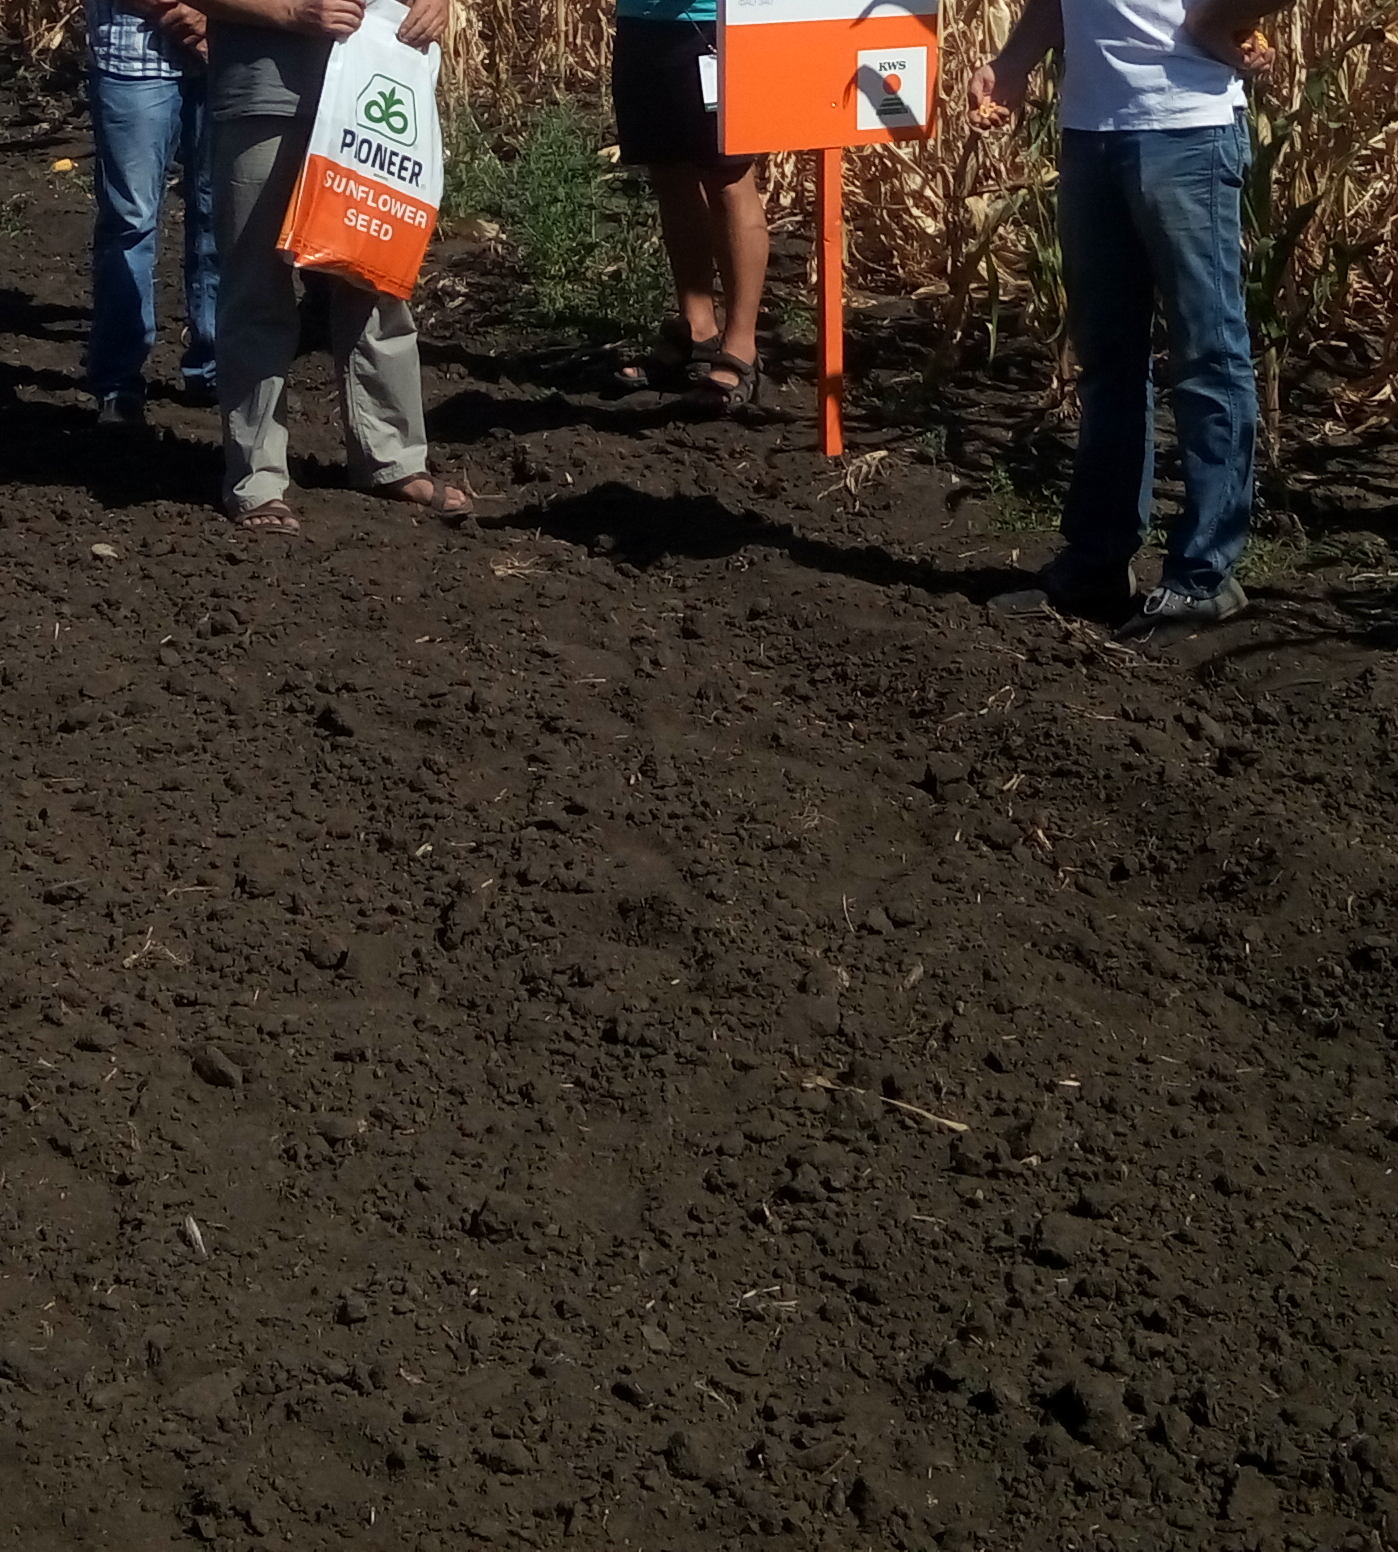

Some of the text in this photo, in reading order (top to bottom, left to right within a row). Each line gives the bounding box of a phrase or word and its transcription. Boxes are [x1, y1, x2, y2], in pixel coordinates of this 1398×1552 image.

[879, 60, 907, 72] KWS
[323, 170, 428, 230] SUNFLOWER
[343, 208, 393, 241] SEED
